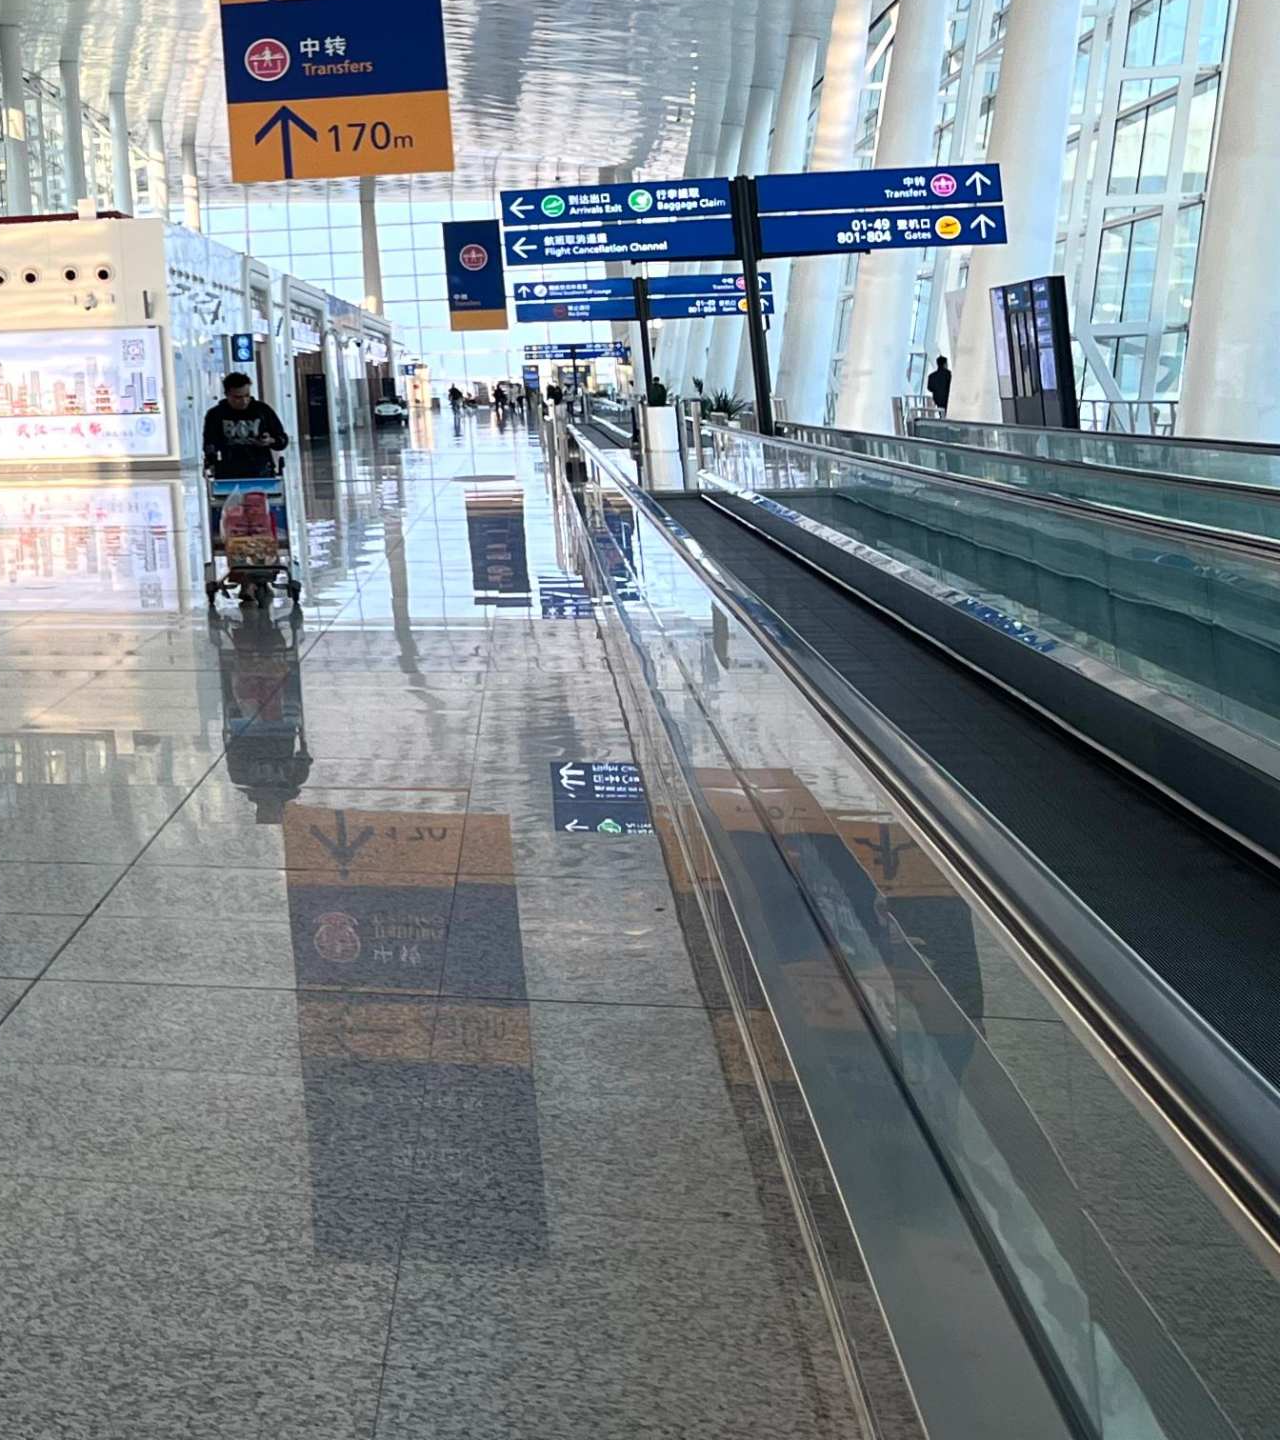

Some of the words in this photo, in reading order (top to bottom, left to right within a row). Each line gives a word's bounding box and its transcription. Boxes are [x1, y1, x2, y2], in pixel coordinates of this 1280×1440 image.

[299, 35, 347, 58] 中转
[302, 60, 373, 76] Transfers
[328, 121, 414, 152] 170m
[884, 188, 927, 199] Transfers
[569, 205, 603, 215] Arrivals
[604, 204, 623, 213] Exit
[657, 201, 698, 211] Baggage
[700, 198, 726, 207] Claim
[904, 231, 932, 240] Gates
[545, 247, 571, 257] Flight
[572, 243, 628, 255] Cancellation
[630, 241, 668, 252] Channel
